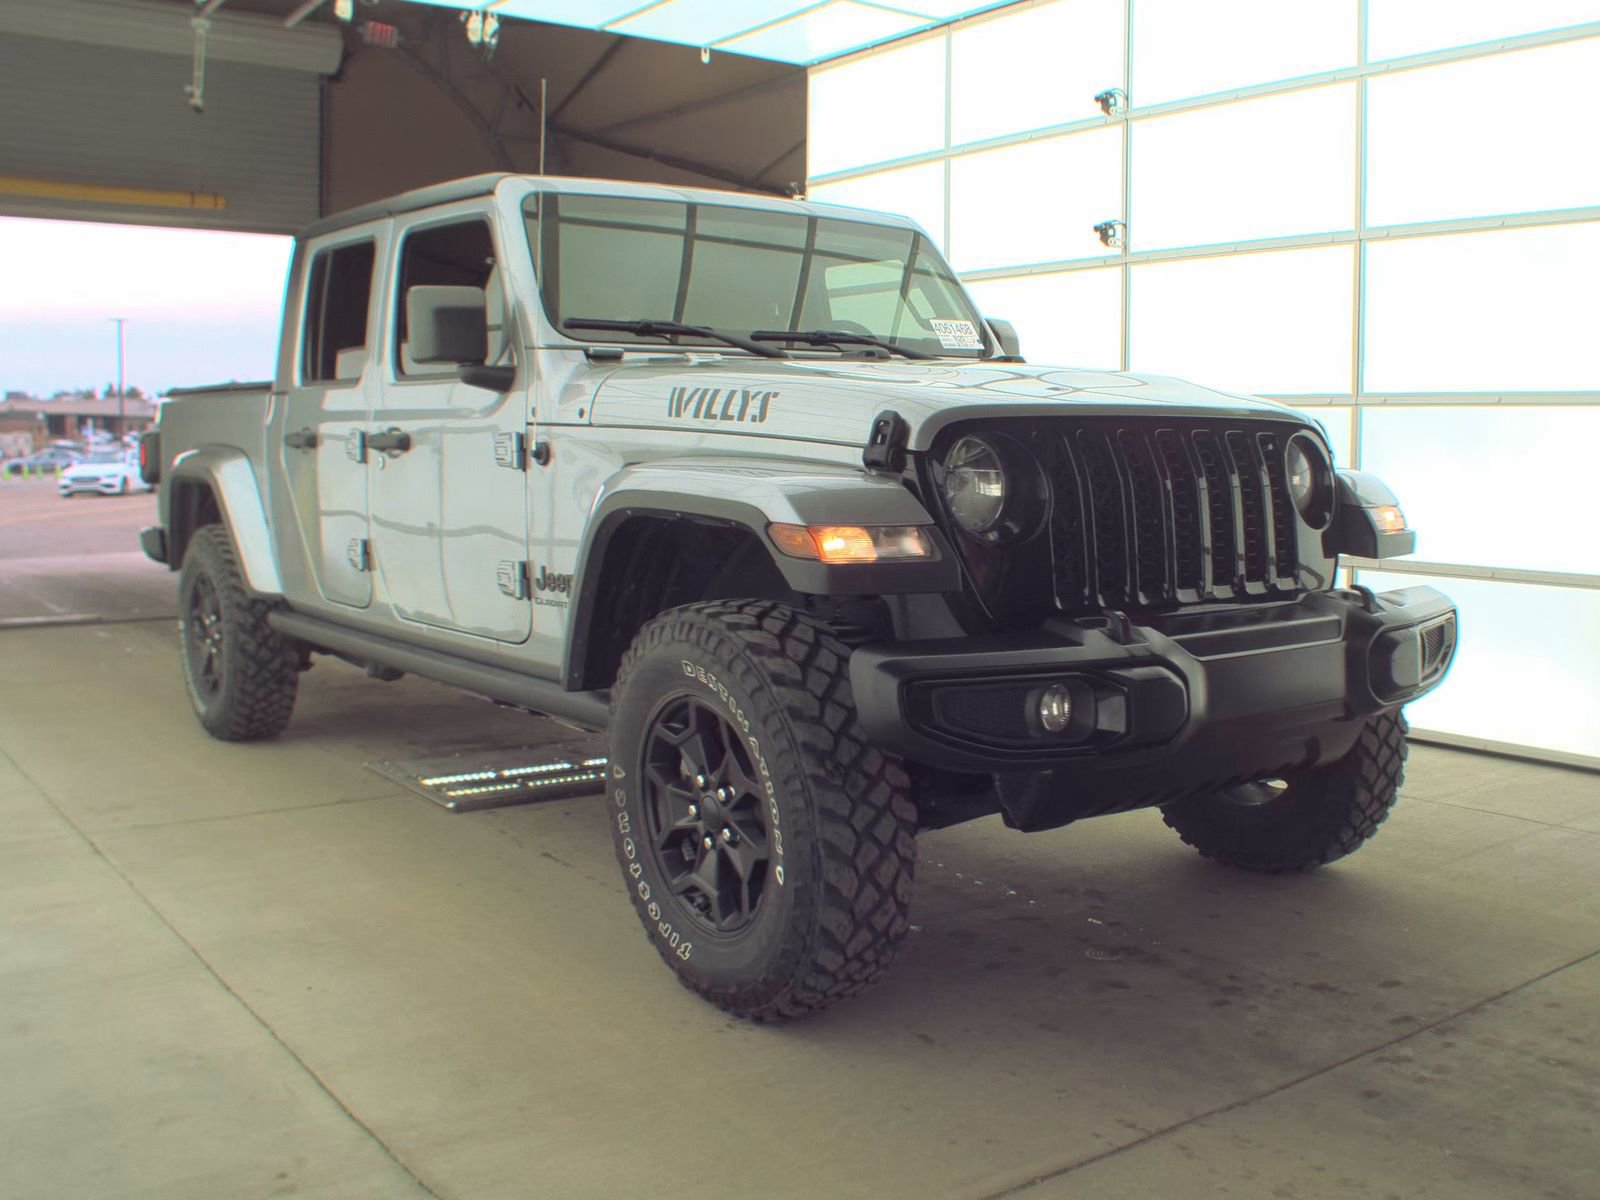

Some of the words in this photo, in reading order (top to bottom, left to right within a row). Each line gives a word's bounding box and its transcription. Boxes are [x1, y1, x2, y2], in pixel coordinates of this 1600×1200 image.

[667, 386, 780, 423] WILLYS
[535, 565, 574, 599] Jeep
[681, 660, 783, 855] DESTINATION
